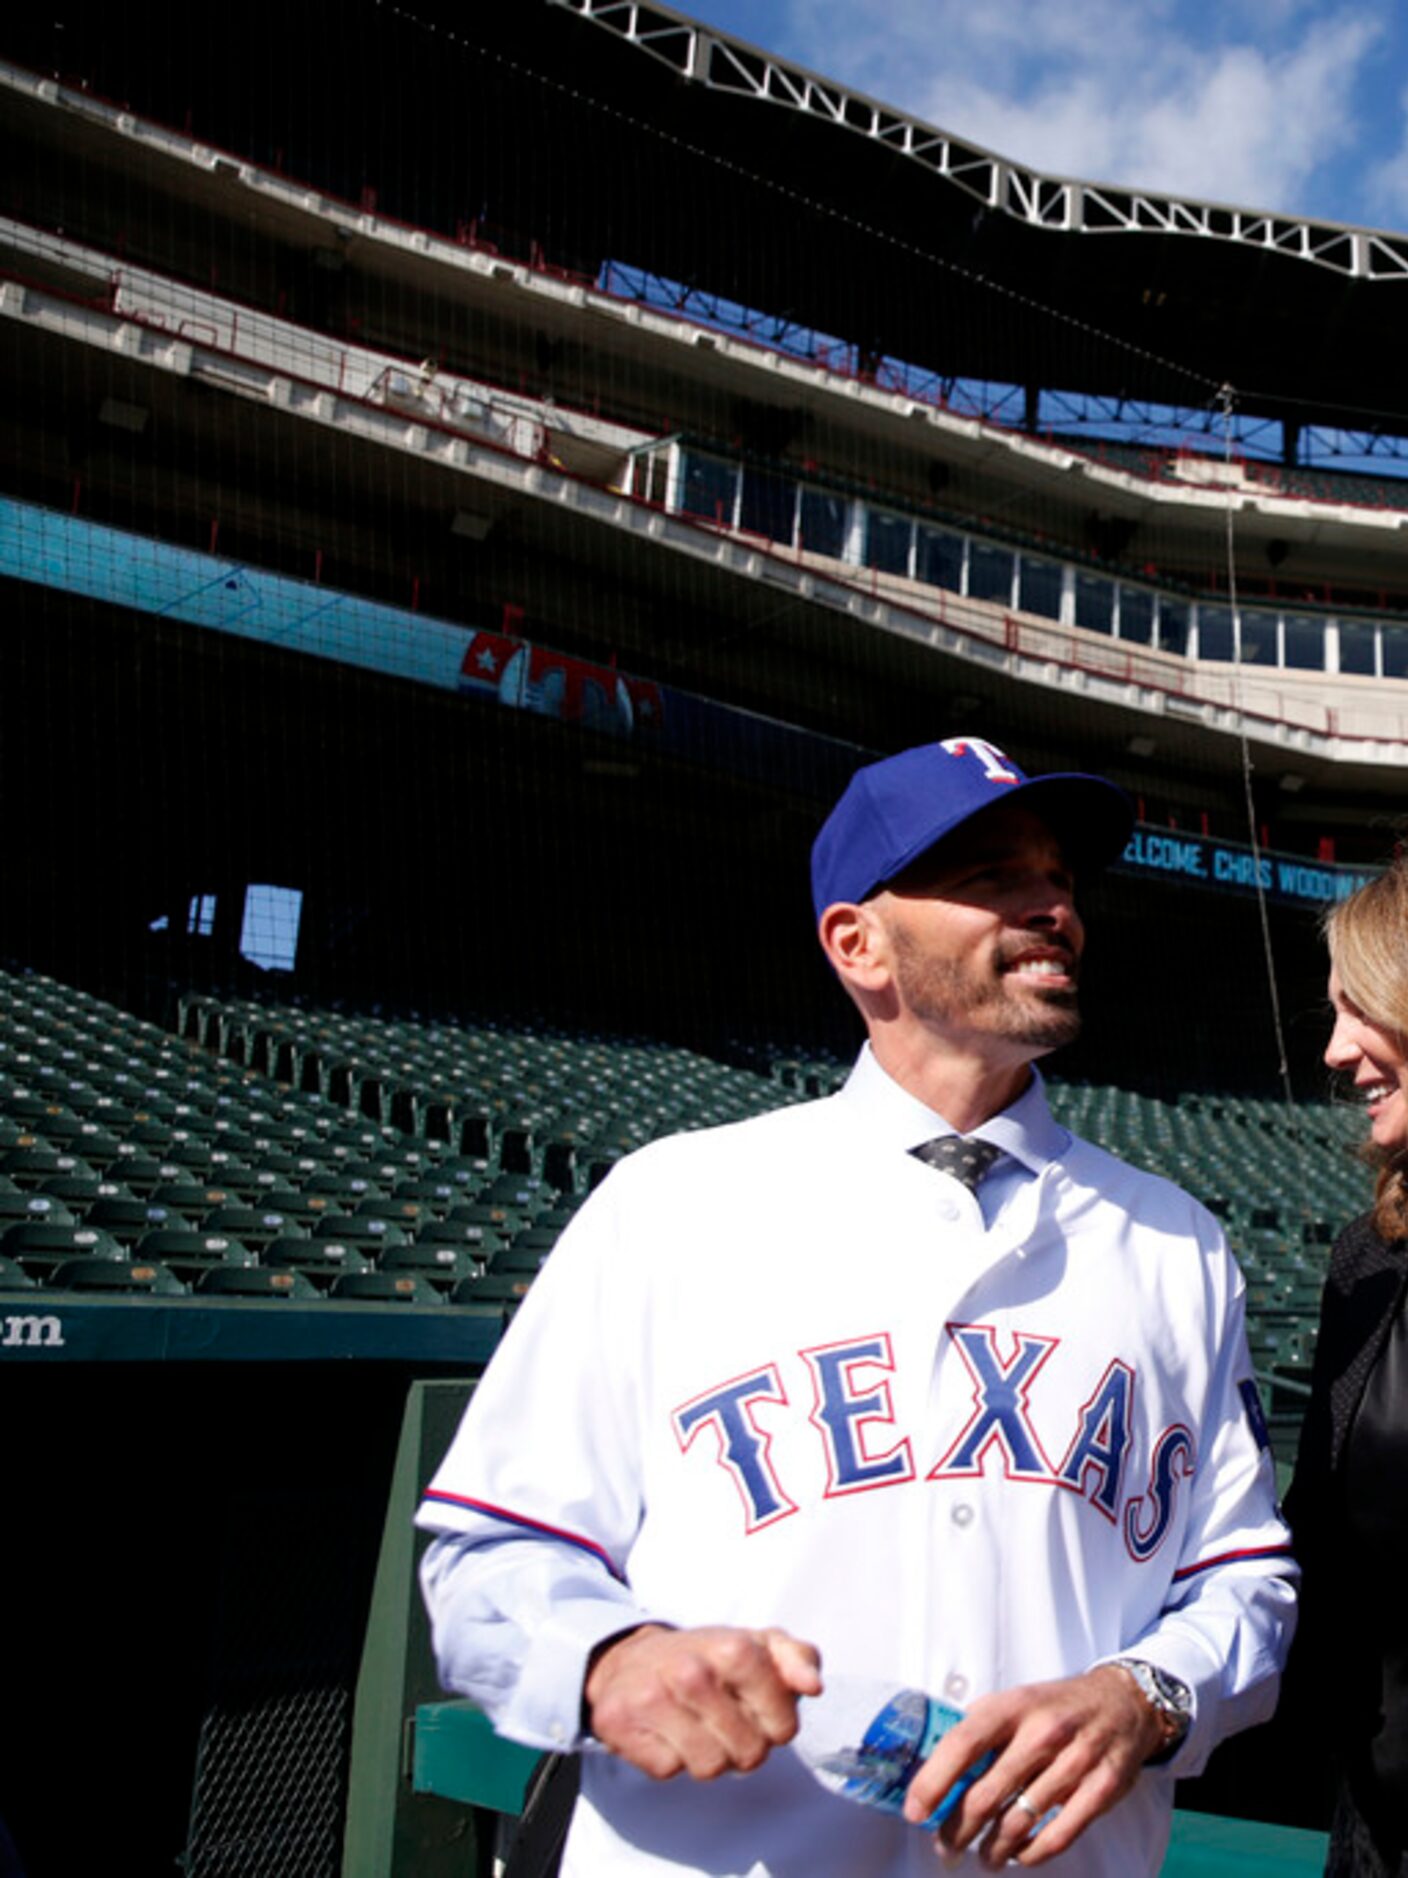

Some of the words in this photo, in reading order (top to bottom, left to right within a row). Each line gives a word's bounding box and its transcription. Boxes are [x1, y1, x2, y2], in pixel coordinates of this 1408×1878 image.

[940, 737, 1022, 784] T
[1123, 832, 1207, 878] ELCOME,
[1213, 848, 1272, 888] CHRIS
[0, 1315, 65, 1346] m
[670, 1322, 1196, 1563] TEXAS
